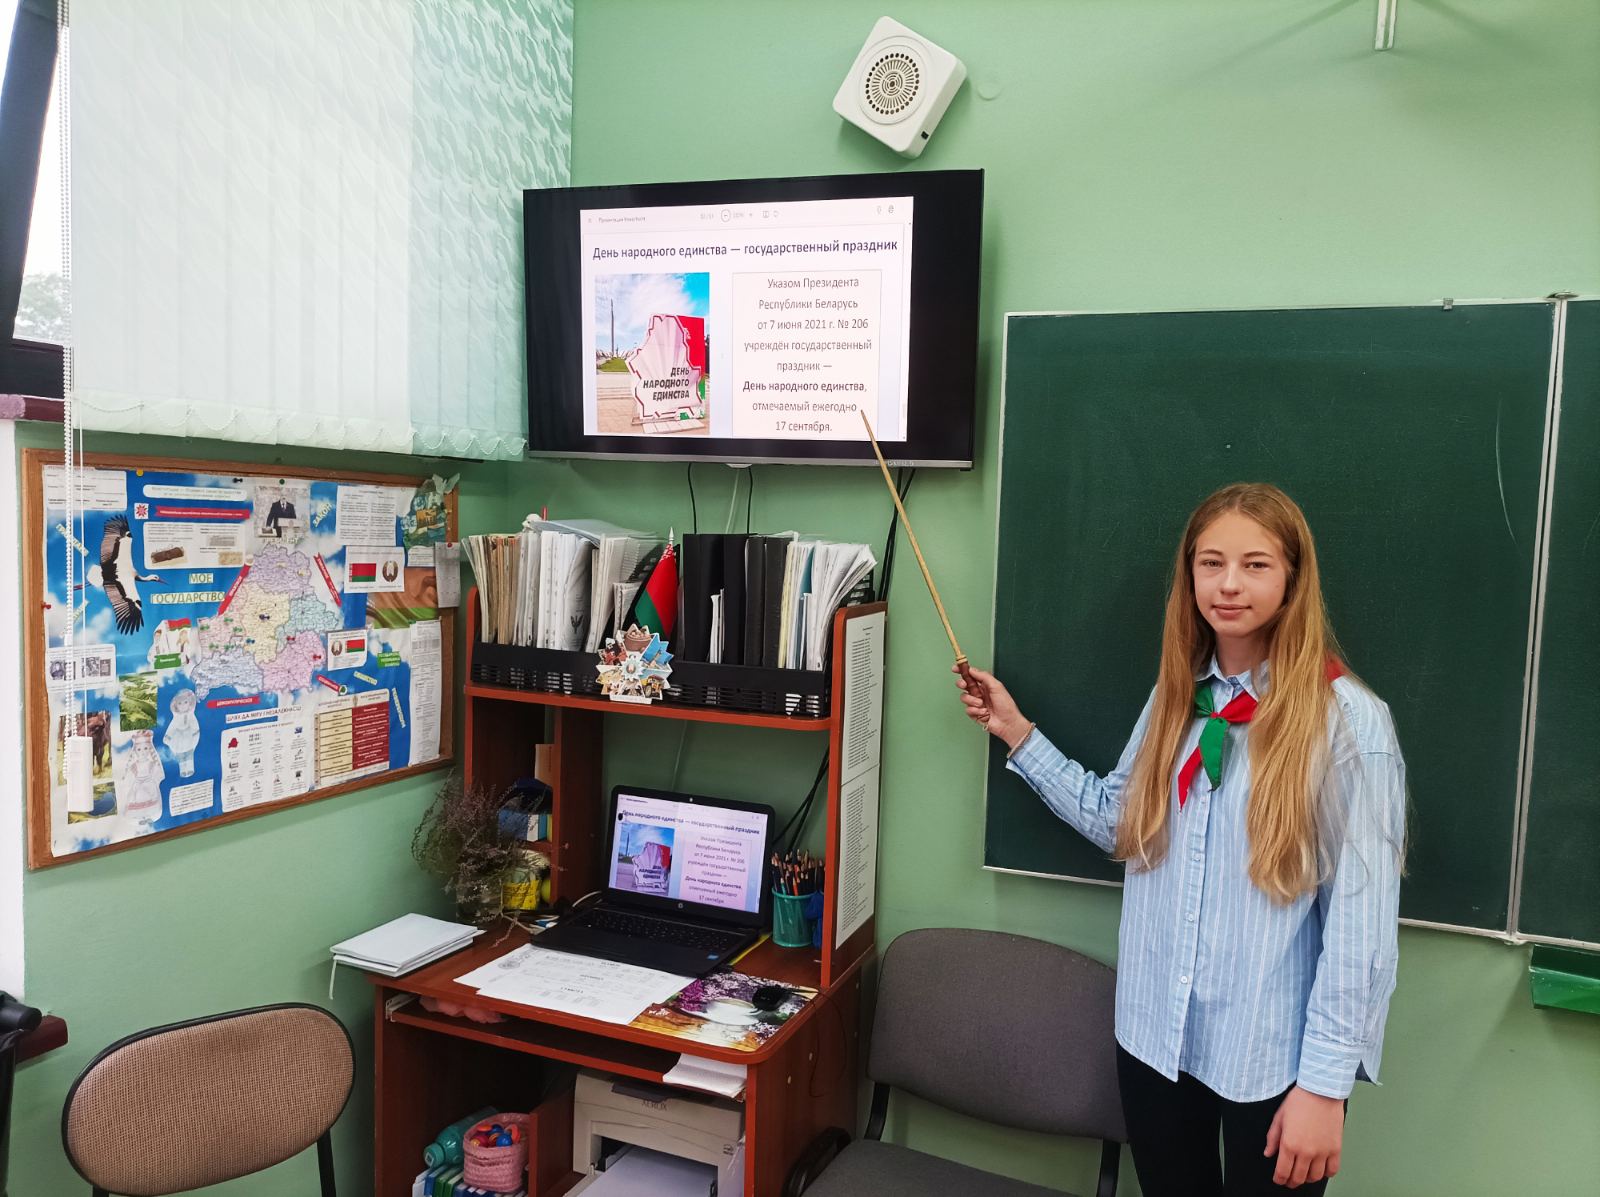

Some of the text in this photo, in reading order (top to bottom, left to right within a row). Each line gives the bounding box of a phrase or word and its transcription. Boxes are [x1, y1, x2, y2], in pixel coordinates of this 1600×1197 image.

[592, 247, 618, 260] День
[621, 246, 676, 260] народного
[678, 245, 727, 259] единства
[744, 240, 839, 256] государственный
[842, 240, 898, 254] праздник
[768, 277, 859, 290] Указом Президента
[758, 298, 858, 311] Республики Беларусь
[757, 318, 869, 330] от 7 июня 2021 г. № 206
[744, 339, 872, 352] учреждён государственный
[670, 367, 690, 377] ДЕНЬ
[776, 362, 820, 373] праздник
[643, 378, 690, 389] НАРОДНОГО
[742, 380, 867, 393] День народного единства,
[652, 390, 690, 401] ЕДИНСТВА
[752, 401, 857, 413] отмечаемый ежегодно
[775, 421, 833, 433] 17 сентября.
[151, 591, 225, 604] ГОСУДАРСТВО
